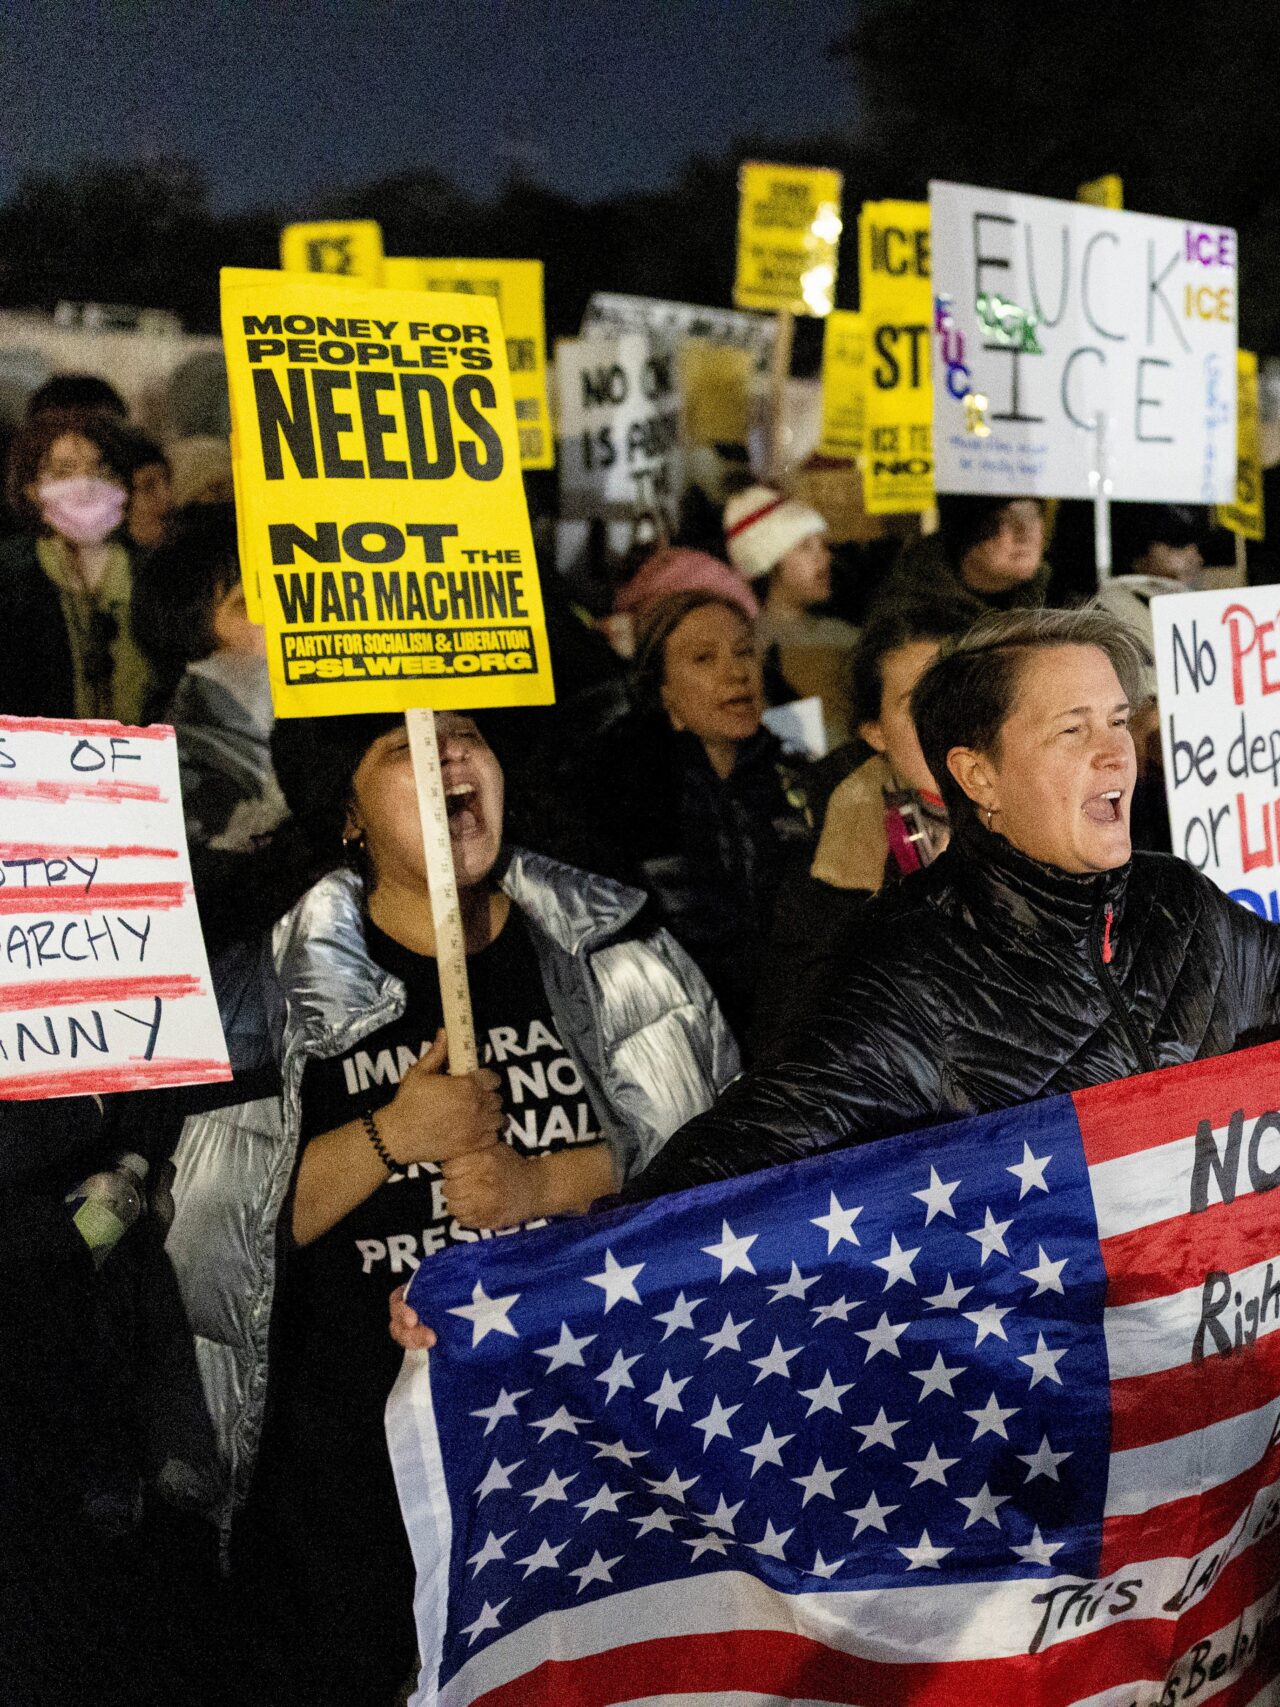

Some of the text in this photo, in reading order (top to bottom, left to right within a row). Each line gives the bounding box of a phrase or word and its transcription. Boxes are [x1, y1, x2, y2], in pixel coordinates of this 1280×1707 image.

[871, 226, 930, 278] ICE
[1185, 229, 1234, 267] ICE
[973, 212, 1194, 355] FUCK
[1185, 284, 1233, 324] ICE
[243, 315, 490, 345] MONEY FOR
[247, 339, 493, 371] PEOPLE'S
[983, 346, 1174, 444] ICE
[253, 368, 504, 482] NEEDS
[268, 522, 522, 565] NOT THE
[274, 570, 529, 624] WAR MACHINE
[285, 629, 530, 658] PARTY FOR SOCIALISM & LIBERATION
[287, 652, 534, 681] PSLWEB.ORG
[1172, 620, 1217, 696] No
[70, 737, 142, 772] OF
[1169, 713, 1218, 790] be
[1184, 803, 1231, 870] or
[1031, 1577, 1144, 1656] This
